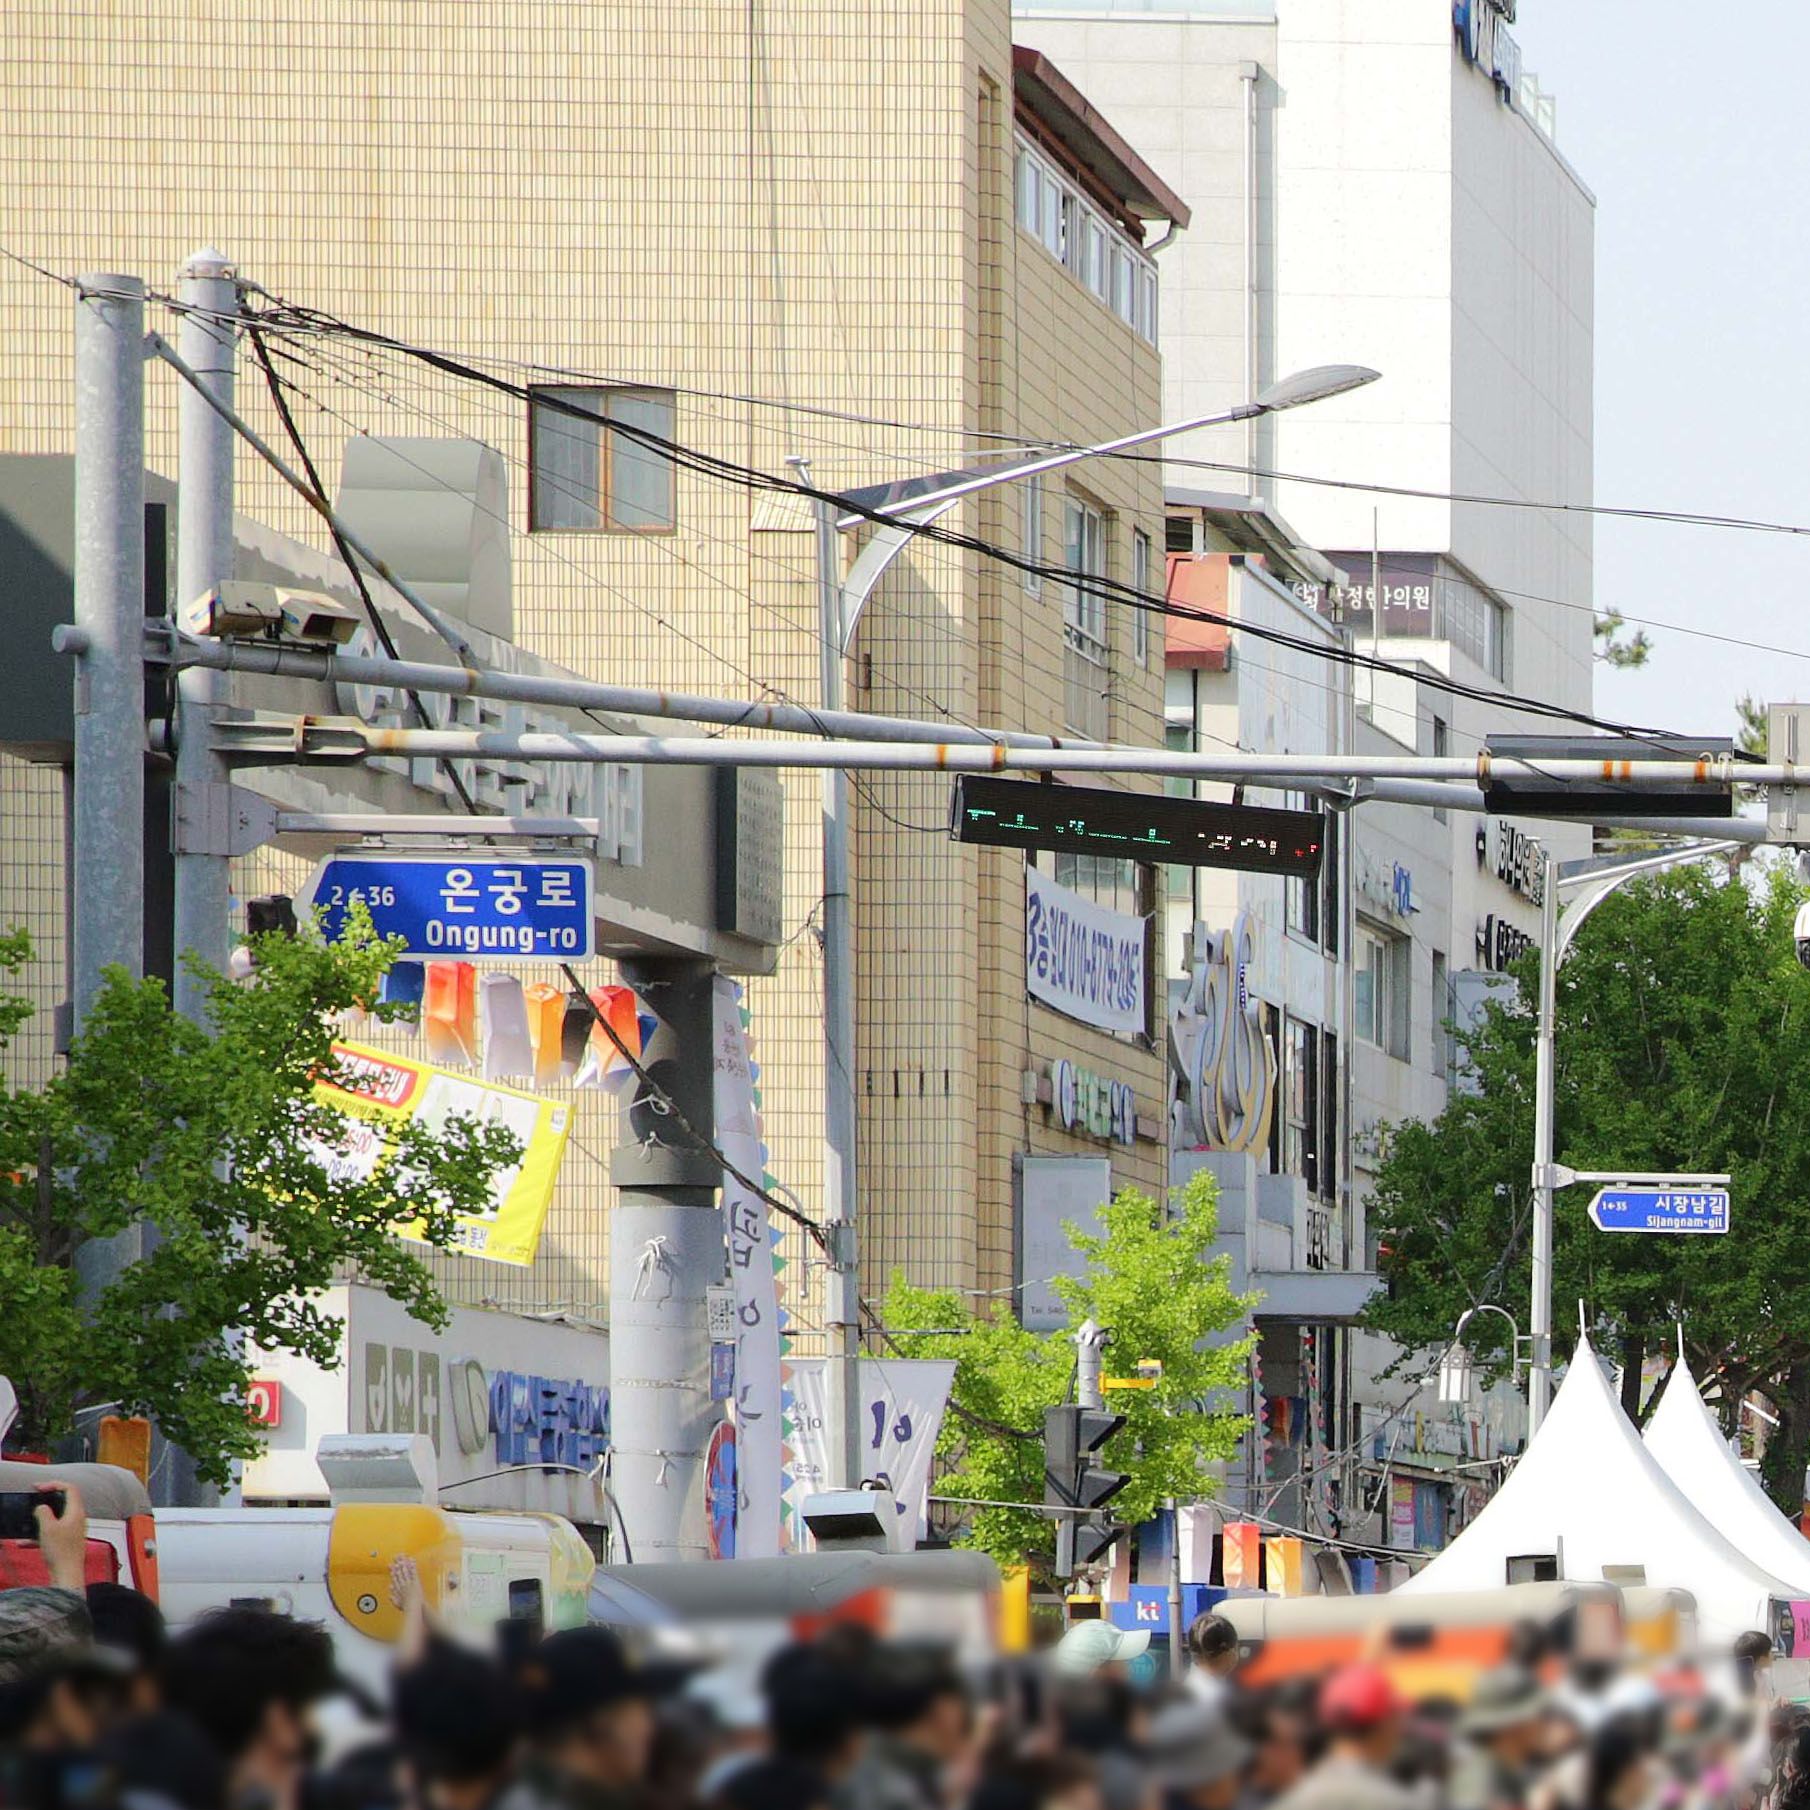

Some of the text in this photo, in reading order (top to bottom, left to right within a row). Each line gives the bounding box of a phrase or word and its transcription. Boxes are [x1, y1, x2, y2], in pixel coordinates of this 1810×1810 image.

[368, 885, 396, 906] 36
[438, 867, 577, 916] 온궁로
[425, 919, 578, 952] Ongung-ro
[1655, 1194, 1724, 1215] 시장남길
[1646, 1215, 1723, 1230] Sijangnam-gil
